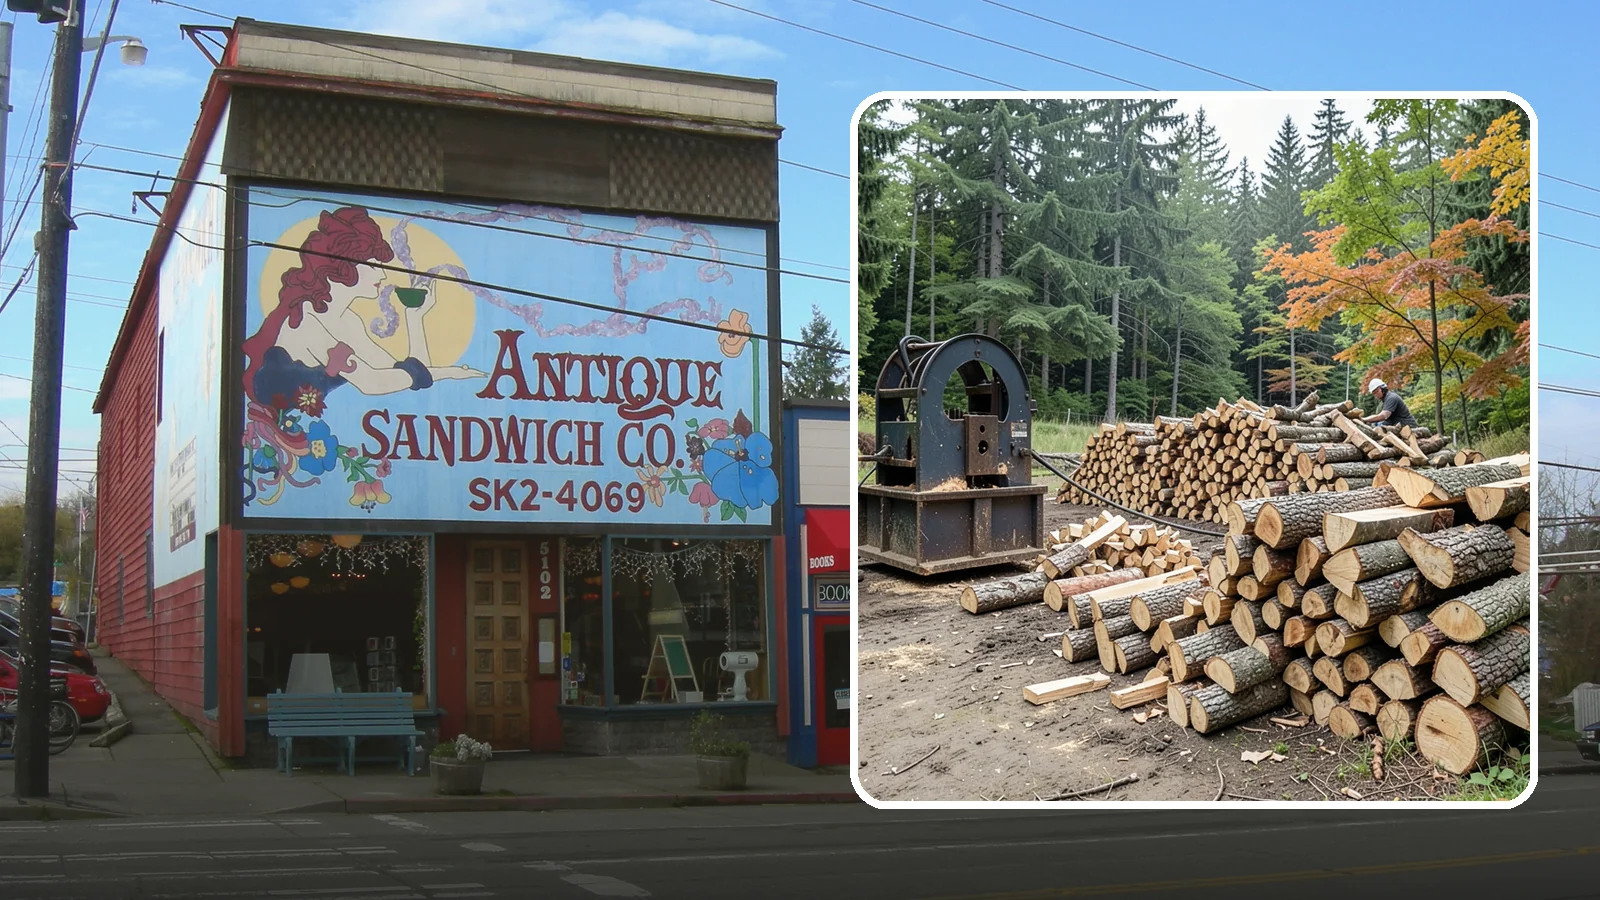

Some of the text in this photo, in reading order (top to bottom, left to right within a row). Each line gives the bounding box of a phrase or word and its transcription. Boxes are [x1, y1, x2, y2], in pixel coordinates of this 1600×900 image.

[476, 329, 723, 420] ANTIQUE
[361, 408, 685, 469] SANDWICH CO.
[468, 477, 646, 513] SK2-4069
[539, 541, 552, 600] 5102
[809, 555, 835, 569] BOOKS
